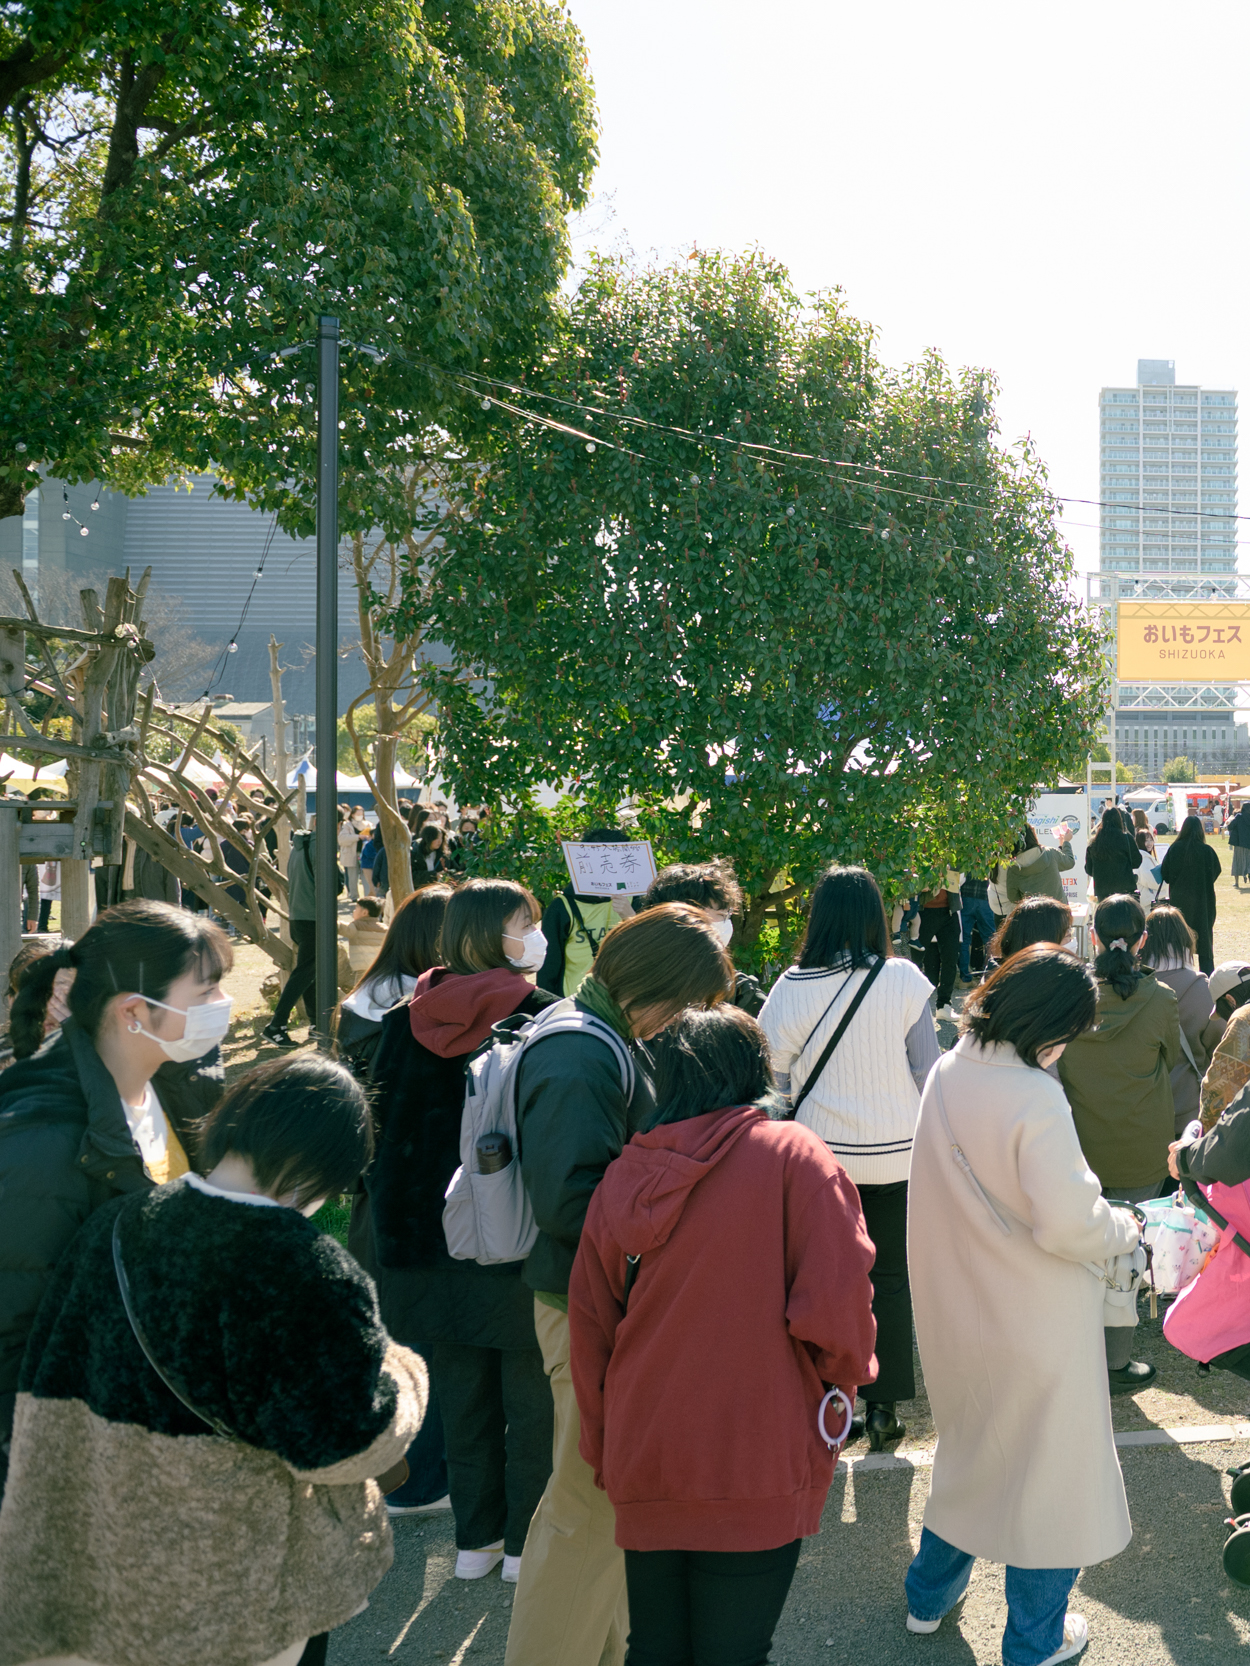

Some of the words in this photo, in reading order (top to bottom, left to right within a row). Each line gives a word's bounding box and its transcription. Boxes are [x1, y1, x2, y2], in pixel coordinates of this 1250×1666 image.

[1143, 624, 1242, 644] おいもフェス
[1159, 649, 1226, 660] SHIZUOKA
[576, 853, 641, 875] 前売券
